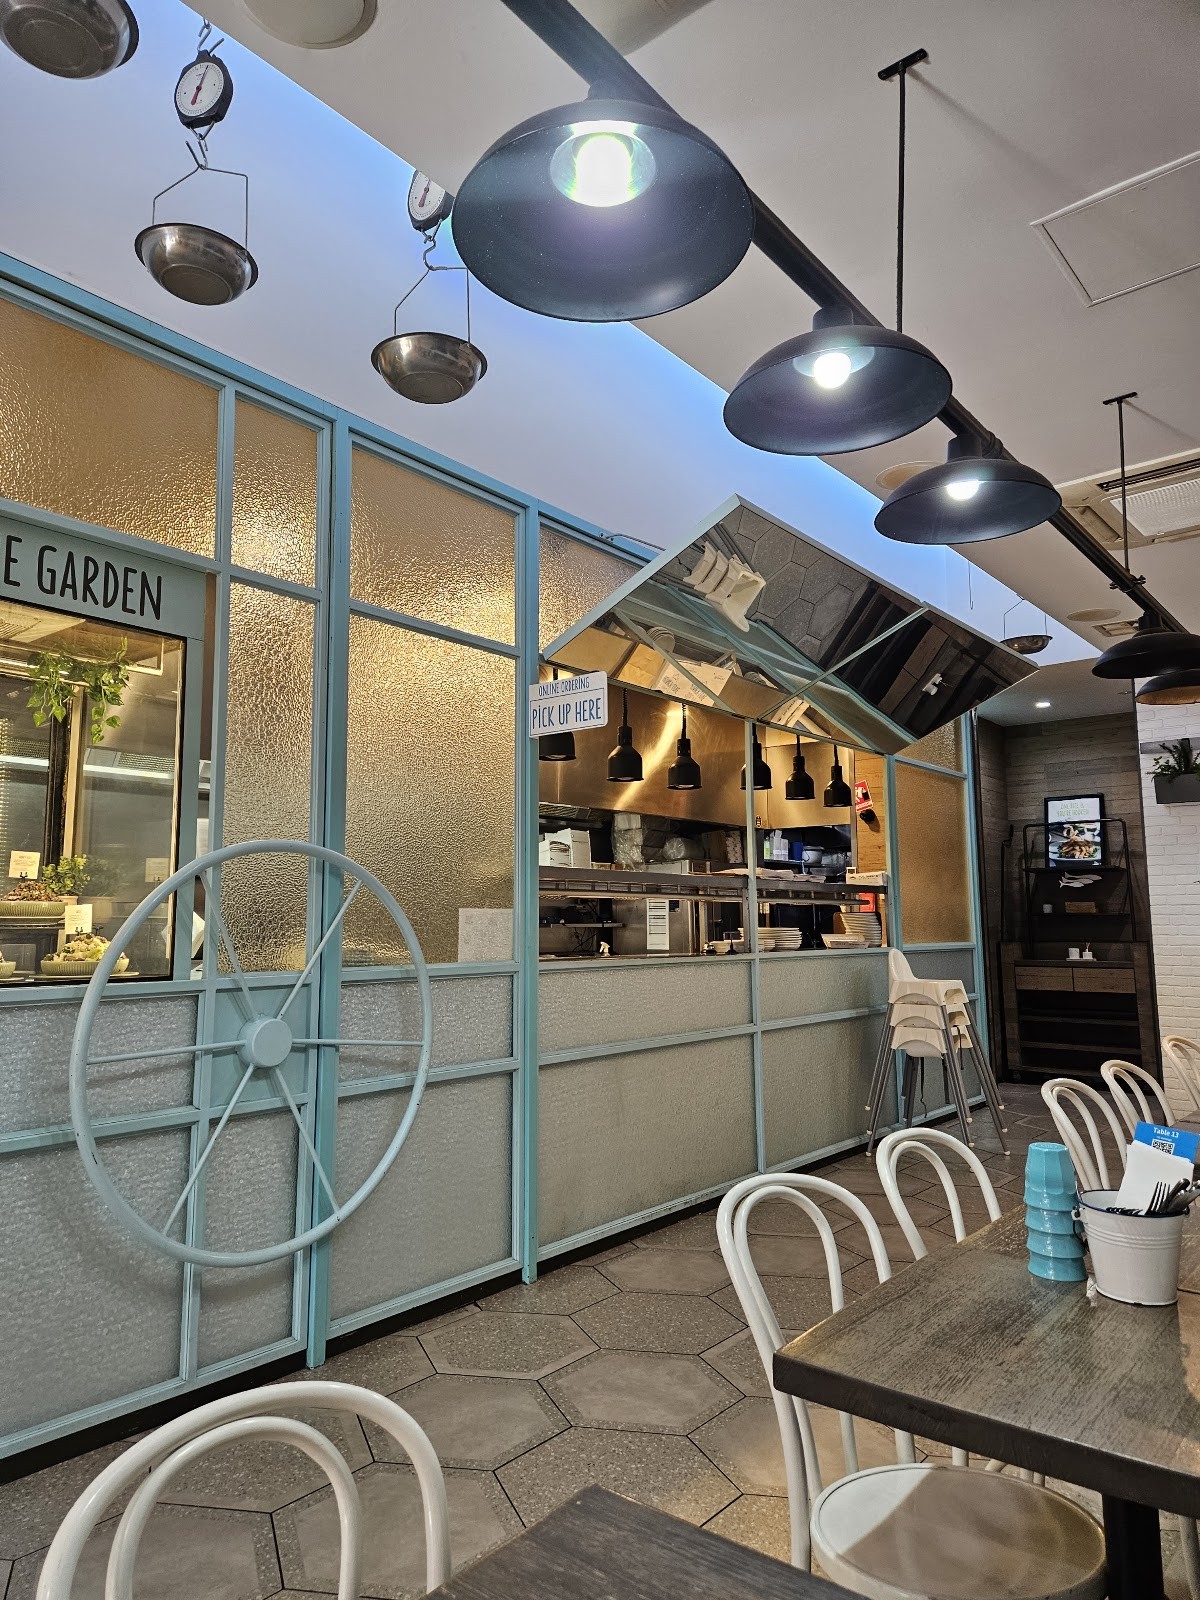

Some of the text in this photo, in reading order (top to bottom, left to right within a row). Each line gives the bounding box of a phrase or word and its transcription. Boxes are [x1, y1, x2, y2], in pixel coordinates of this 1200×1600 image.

[37, 545, 162, 621] GARDEN
[538, 676, 590, 697] ONLINE ORDERING
[532, 698, 602, 730] PICK UP HERE
[1153, 1127, 1171, 1136] Table
